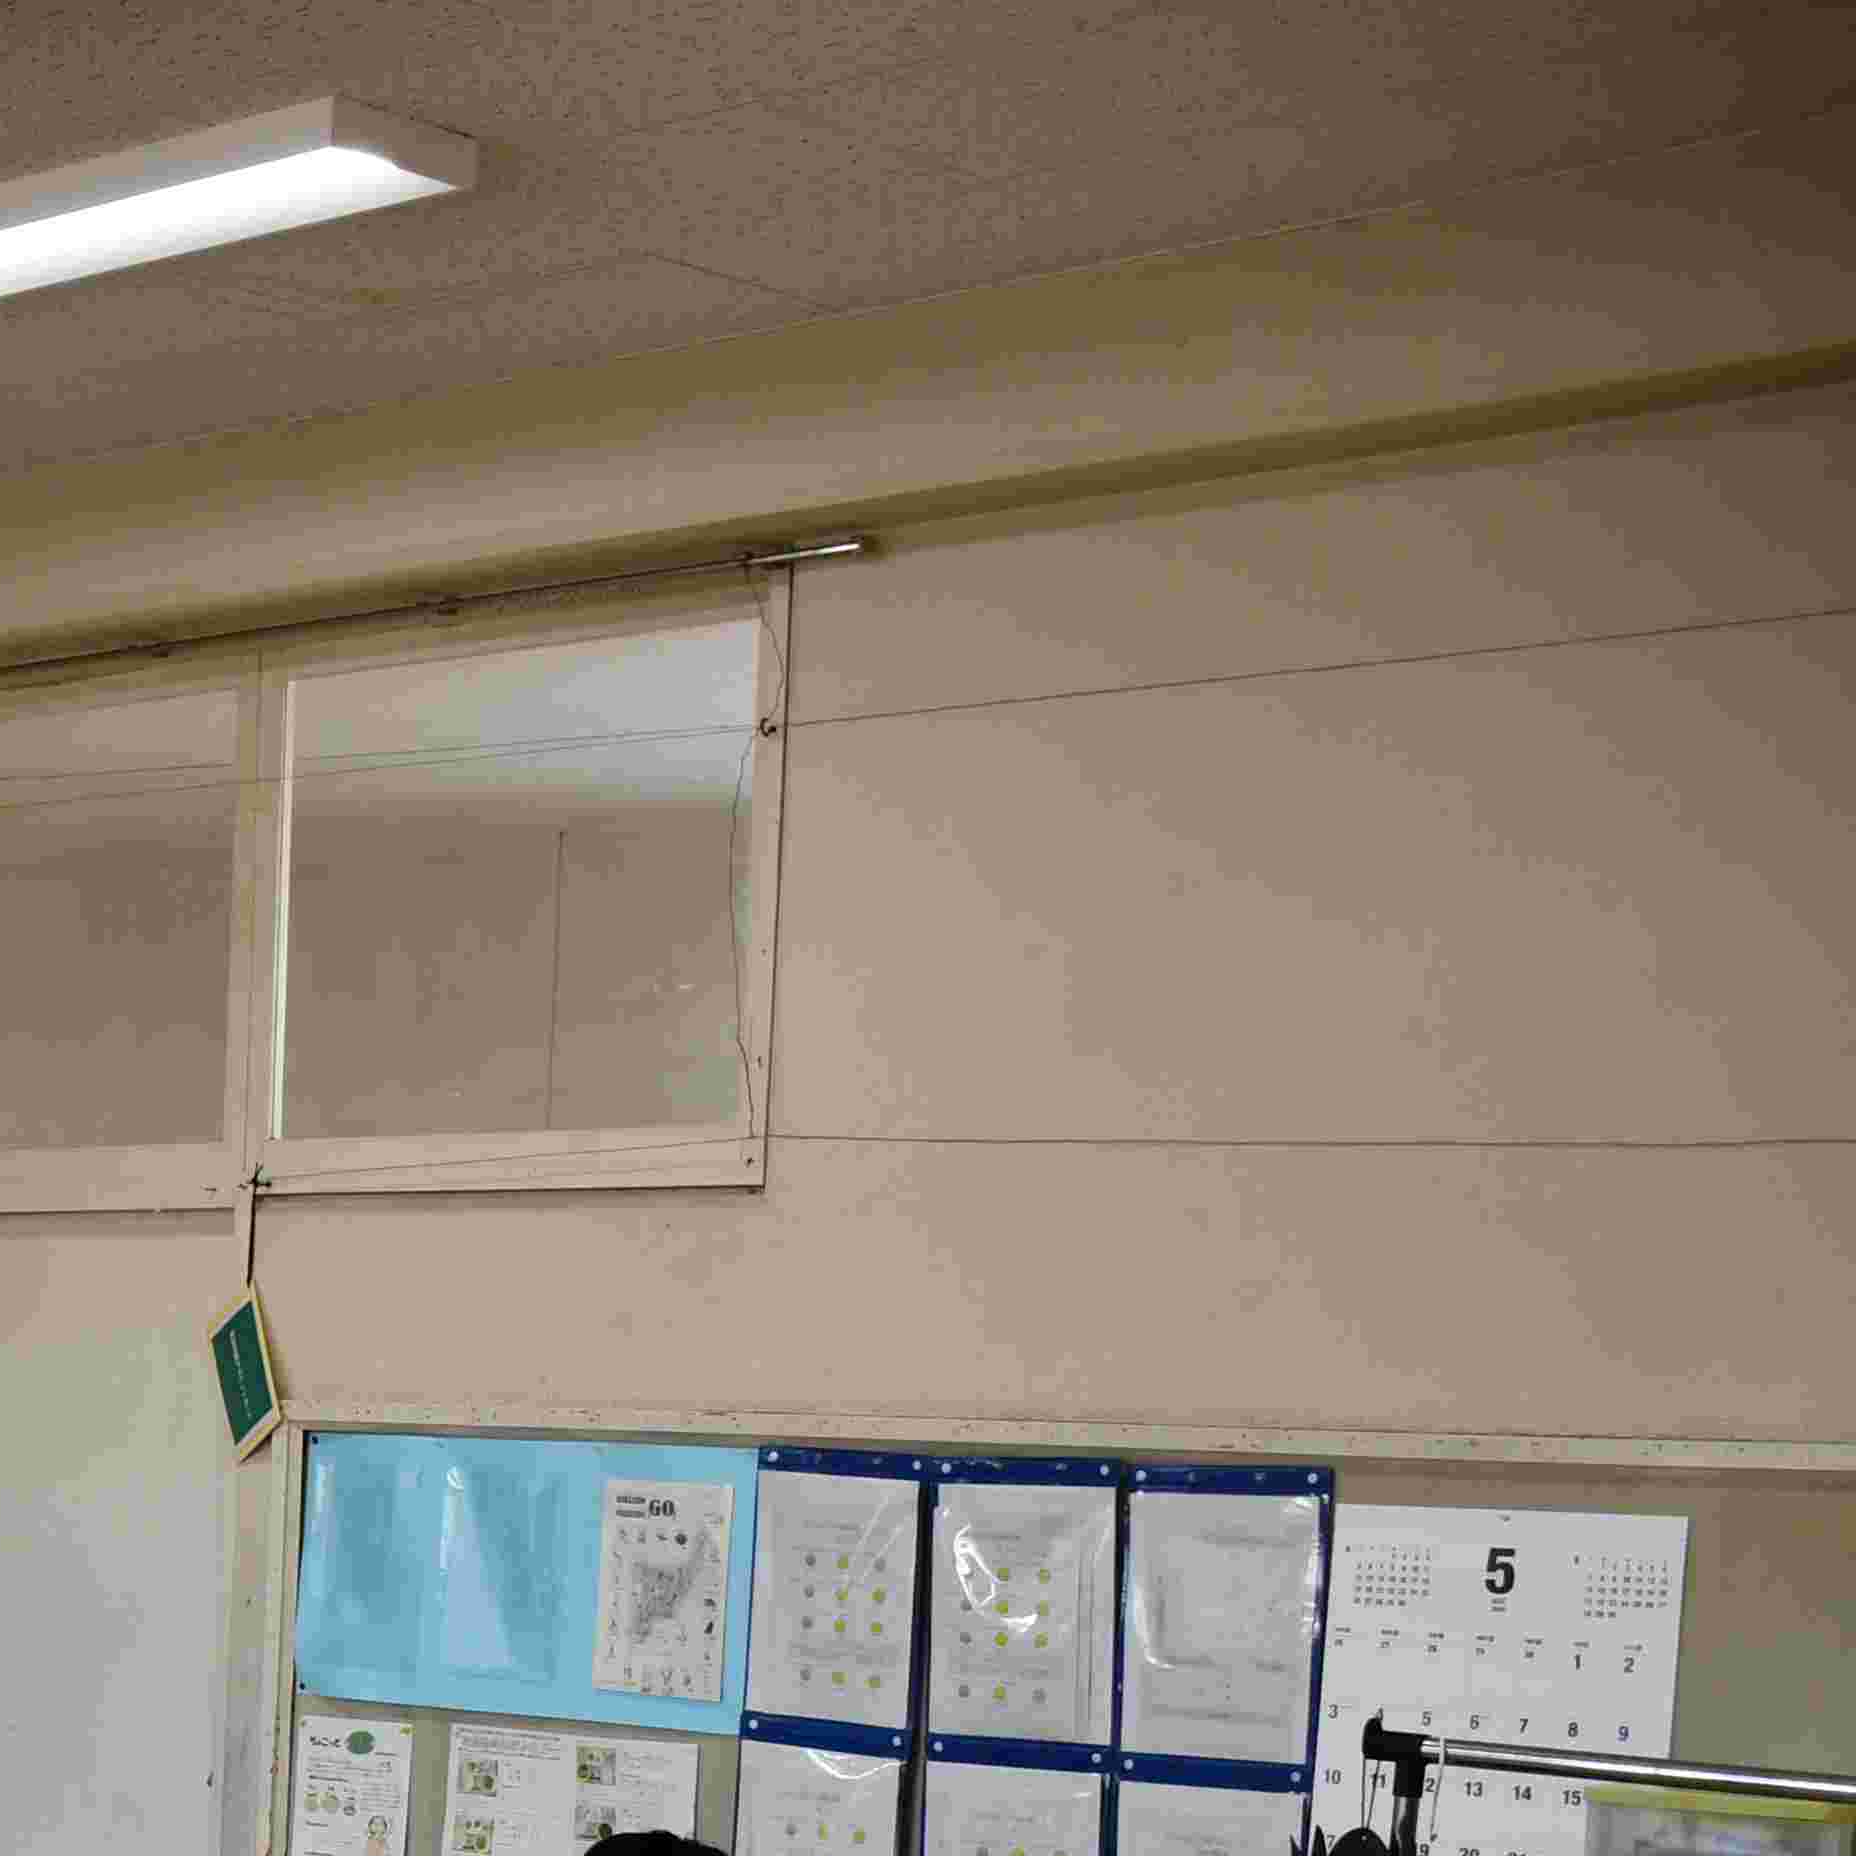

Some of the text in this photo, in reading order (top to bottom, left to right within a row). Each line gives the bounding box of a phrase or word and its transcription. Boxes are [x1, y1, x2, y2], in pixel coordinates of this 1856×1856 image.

[1484, 1547, 1516, 1594] 5
[1573, 1653, 1581, 1671] 1
[1623, 1656, 1635, 1673] 2
[1328, 1704, 1339, 1719] 3
[1421, 1711, 1432, 1726] 5
[1469, 1714, 1480, 1729] 6
[1519, 1718, 1529, 1734] 7
[1567, 1722, 1579, 1738] 8
[1618, 1726, 1629, 1742] 9
[1325, 1769, 1341, 1785] 10
[1371, 1773, 1386, 1789] 11
[1424, 1777, 1436, 1792] 2
[1464, 1781, 1483, 1797] 13
[1513, 1785, 1532, 1801] 14
[1563, 1790, 1582, 1806] 15
